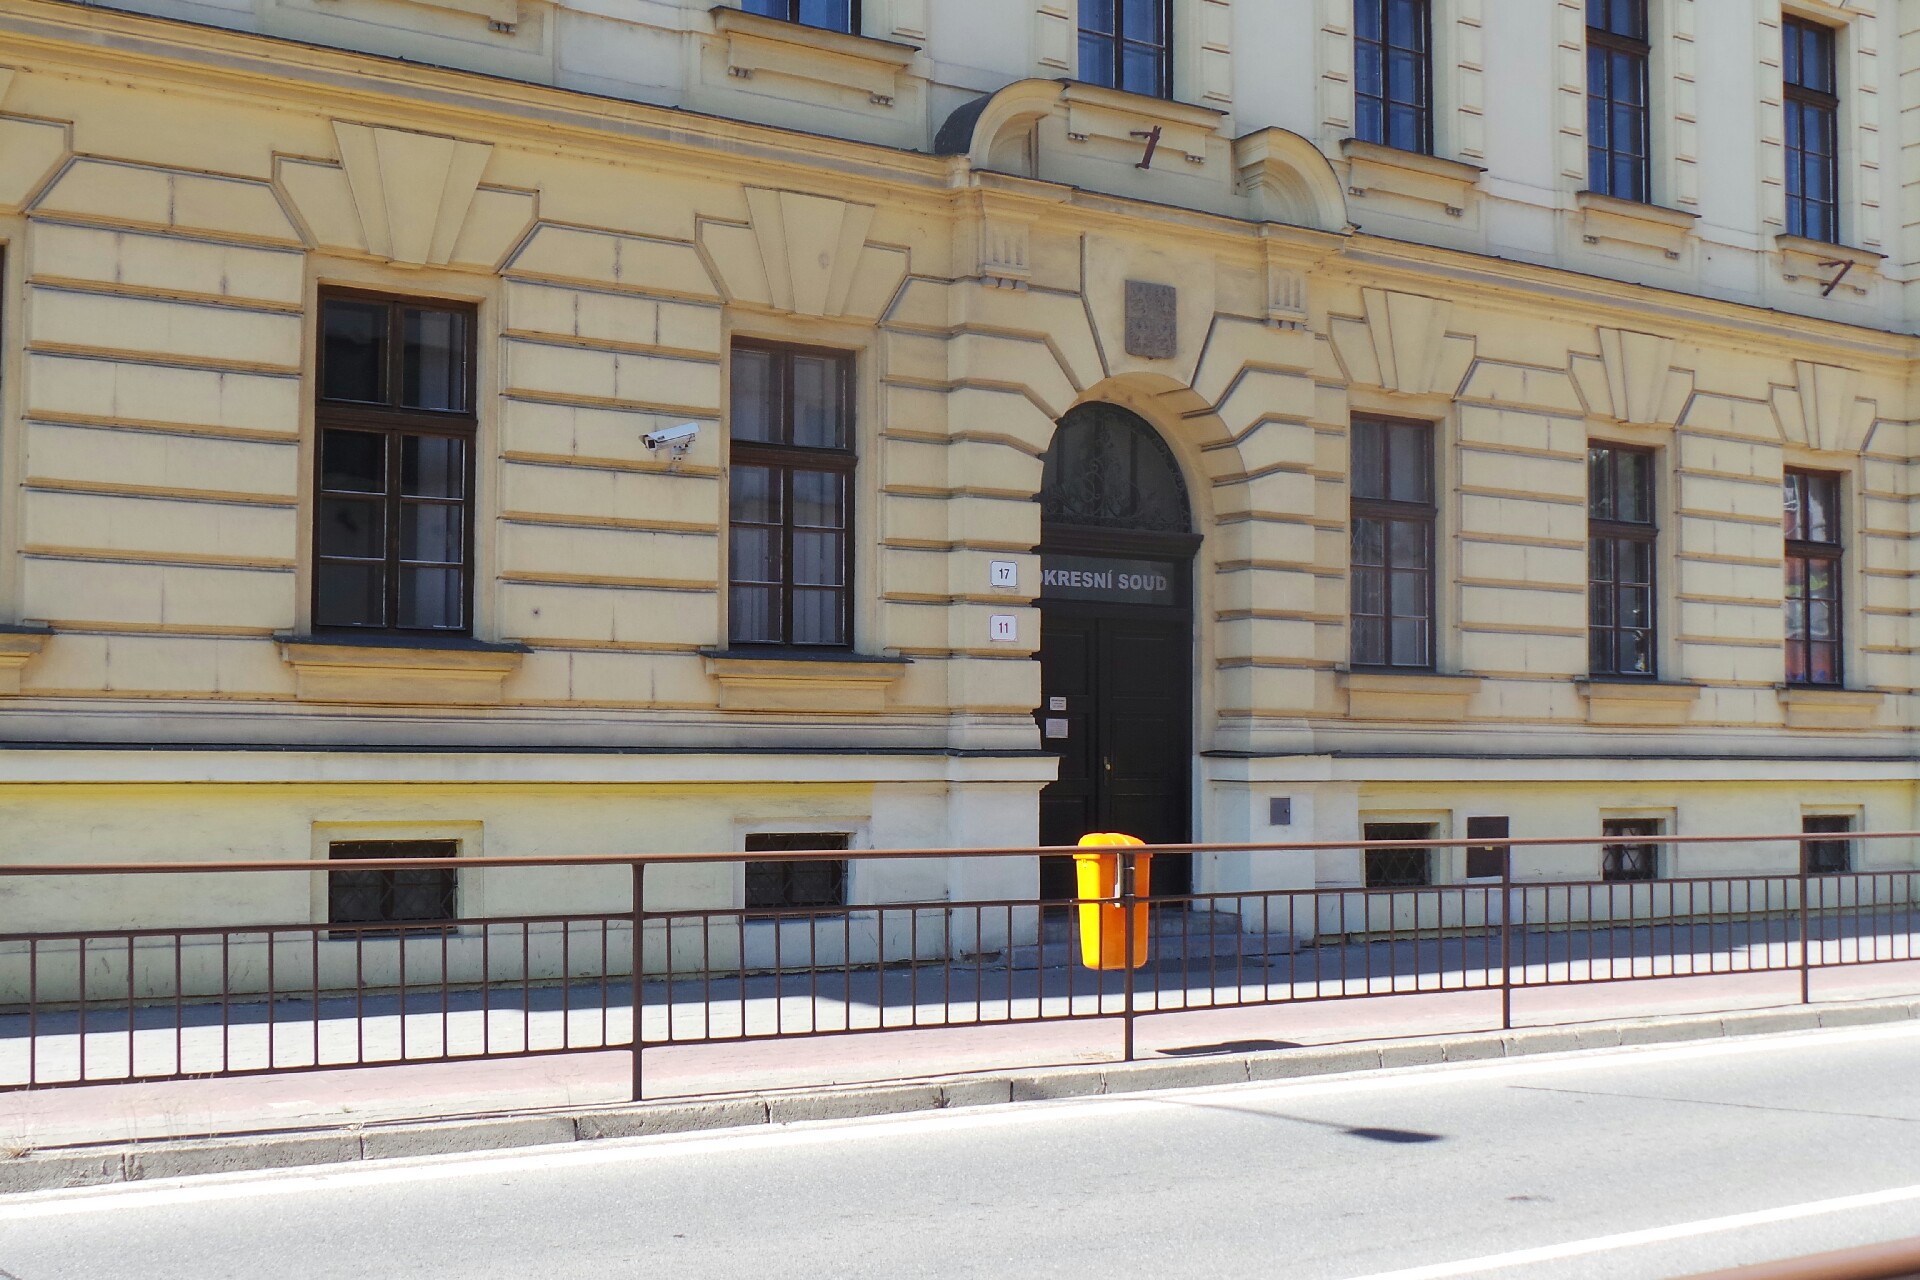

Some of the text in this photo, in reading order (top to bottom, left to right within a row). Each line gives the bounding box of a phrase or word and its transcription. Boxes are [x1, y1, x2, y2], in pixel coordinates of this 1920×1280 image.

[998, 568, 1010, 580] 17
[1040, 569, 1167, 591] KRESNÍ SOUD
[998, 622, 1009, 634] 11
